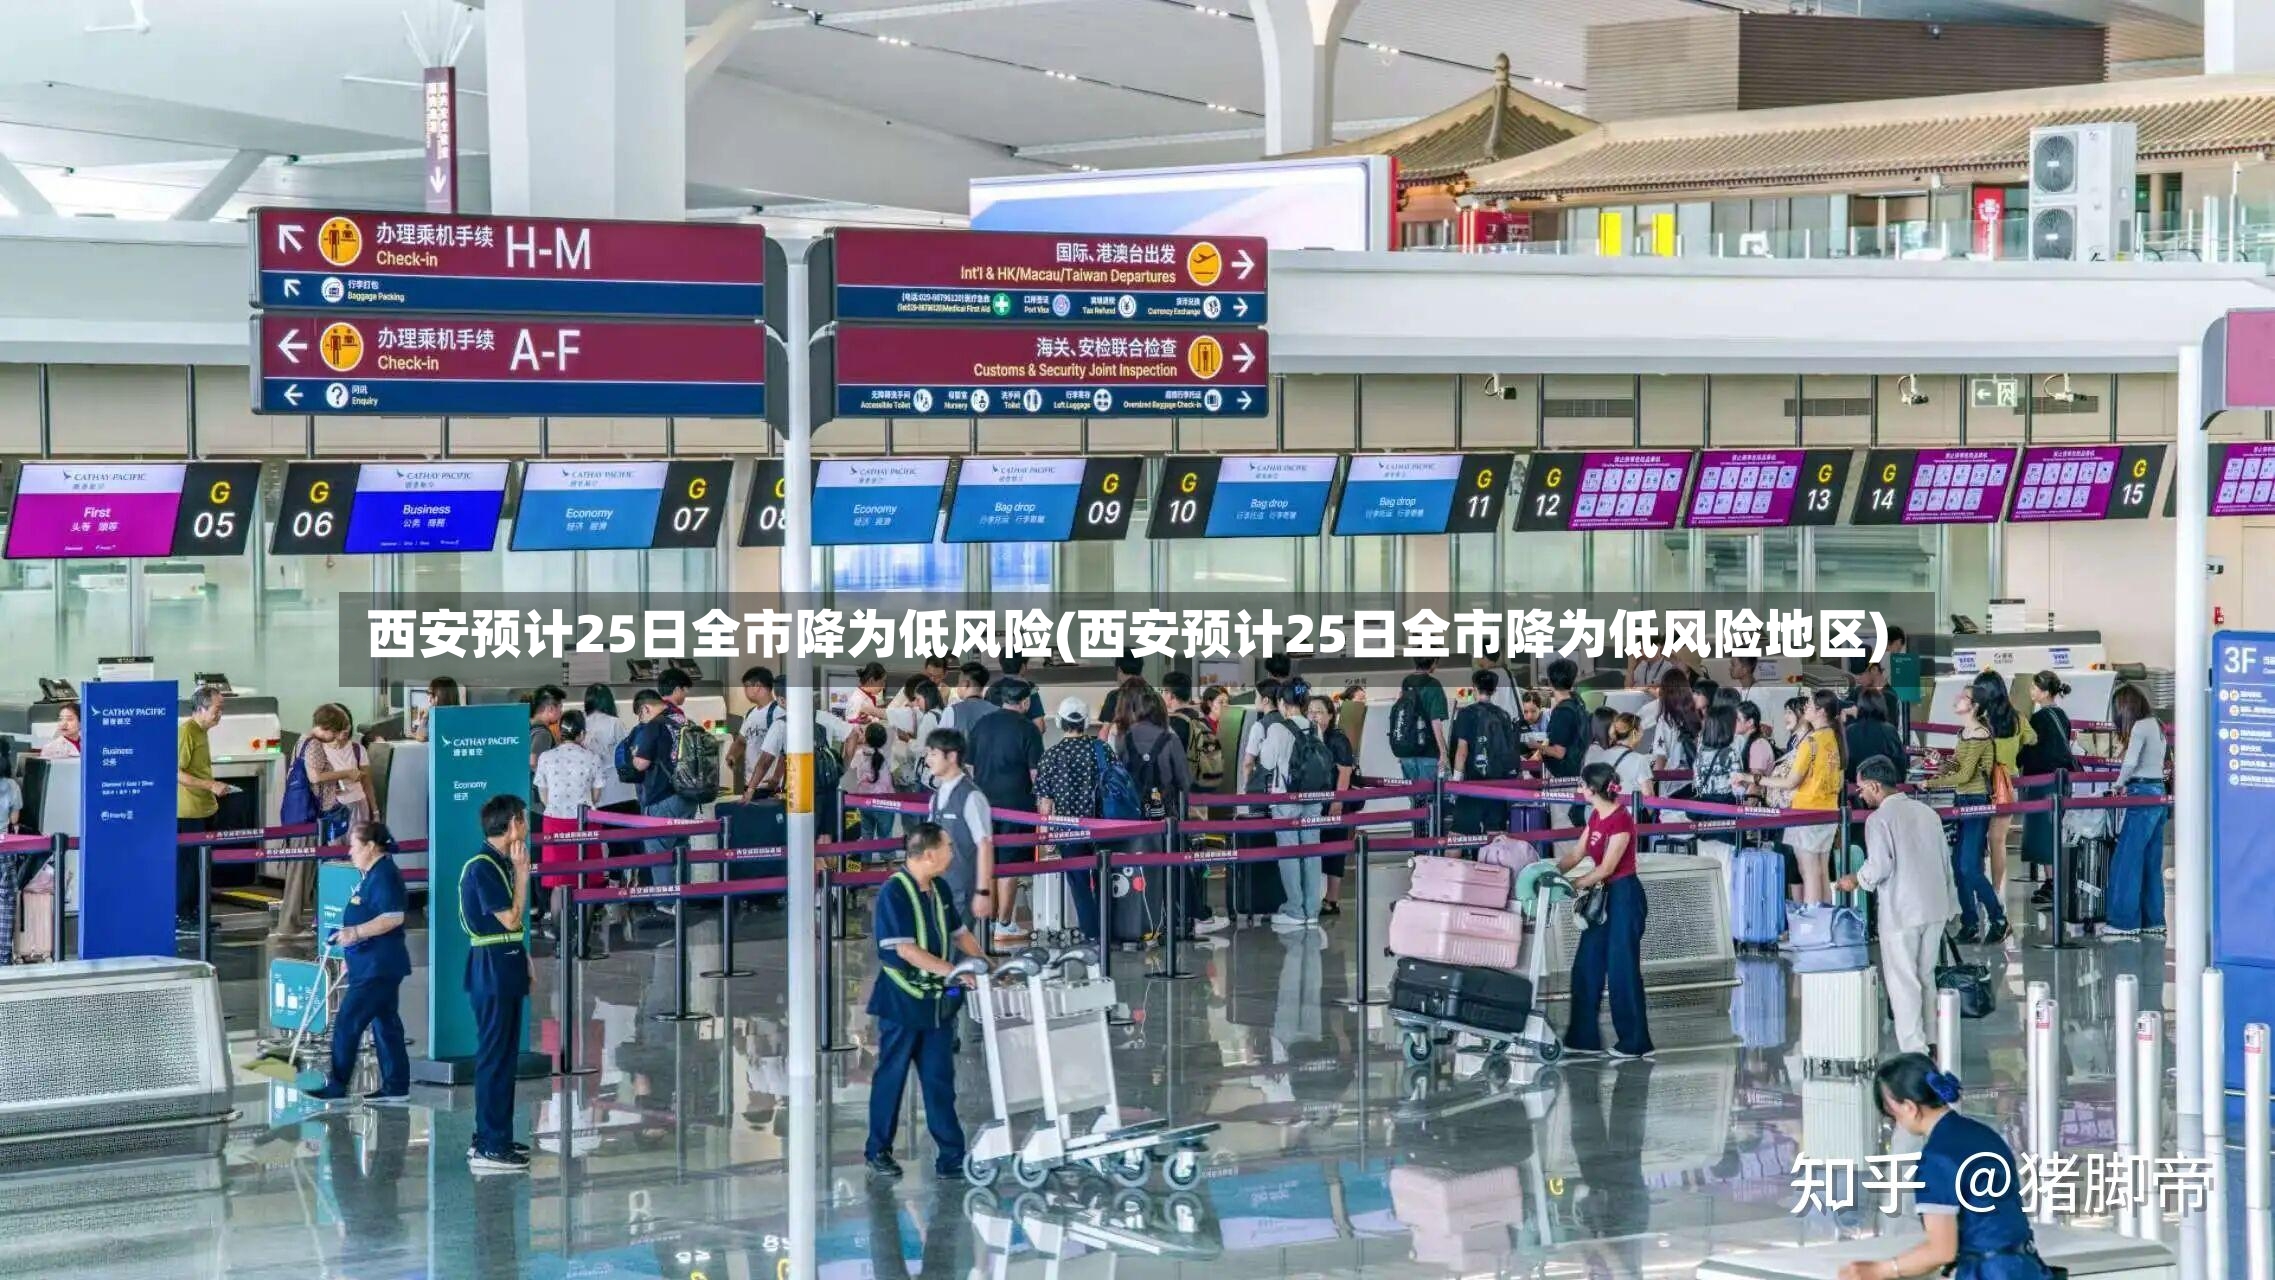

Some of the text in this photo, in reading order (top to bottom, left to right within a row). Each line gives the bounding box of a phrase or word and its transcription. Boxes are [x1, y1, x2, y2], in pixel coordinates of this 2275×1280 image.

[376, 224, 493, 248] 办理乘机手续
[507, 226, 591, 269] H-M
[1056, 243, 1176, 264] 国际、港澳台出发
[377, 251, 438, 267] Check-in
[985, 268, 995, 280] &
[997, 267, 1108, 283] HK/Macau/Taiwan
[1111, 268, 1176, 286] Departures
[348, 291, 404, 302] Baggage Packing
[966, 304, 980, 312] First
[981, 304, 991, 312] Aid
[1037, 305, 1049, 313] Visa
[1173, 308, 1200, 316] Exchange
[378, 328, 495, 350] 办理乘机手续
[1036, 338, 1177, 359] 海关、安检联合检查
[510, 329, 580, 371] A-F
[378, 355, 439, 371] Check-in
[974, 364, 1177, 381] Customs & Security Joint Inspection
[352, 397, 378, 406] Enquiry
[894, 401, 911, 409] Toilet
[1004, 401, 1020, 409] Toilet
[1066, 402, 1090, 410] Luggage
[1152, 401, 1177, 410] Baggage
[1177, 401, 1202, 409] Check-in
[74, 472, 146, 481] CATHAY PACIFIC
[1546, 468, 1562, 487] G
[1818, 464, 1833, 483] G
[1882, 464, 1897, 483] G
[2133, 459, 2147, 478] G
[1103, 473, 1119, 493] G
[1181, 472, 1197, 492] G
[1476, 469, 1492, 488] G
[211, 481, 230, 503] G
[309, 481, 329, 503] G
[688, 478, 706, 499] G
[2122, 483, 2145, 505] 15
[995, 502, 1035, 513] Bag drop
[1250, 499, 1288, 509] Bag drop
[1379, 497, 1416, 507] Bag drop
[1468, 495, 1490, 518] 11
[1536, 494, 1560, 516] 12
[1807, 489, 1831, 510] 13
[1872, 488, 1895, 510] 14
[84, 507, 111, 518] First
[403, 504, 450, 514] Business
[566, 508, 613, 519] Economy
[853, 504, 897, 515] Economy
[1088, 501, 1120, 524] 09
[1170, 500, 1196, 523] 10
[194, 513, 234, 537] 05
[293, 512, 333, 537] 06
[673, 507, 710, 531] 07
[2223, 646, 2257, 673] 3F
[103, 707, 166, 717] CATHAY PACIFIC
[453, 736, 520, 746] CATHAY PACIFIC
[103, 747, 133, 755] Business
[454, 781, 487, 789] Economy
